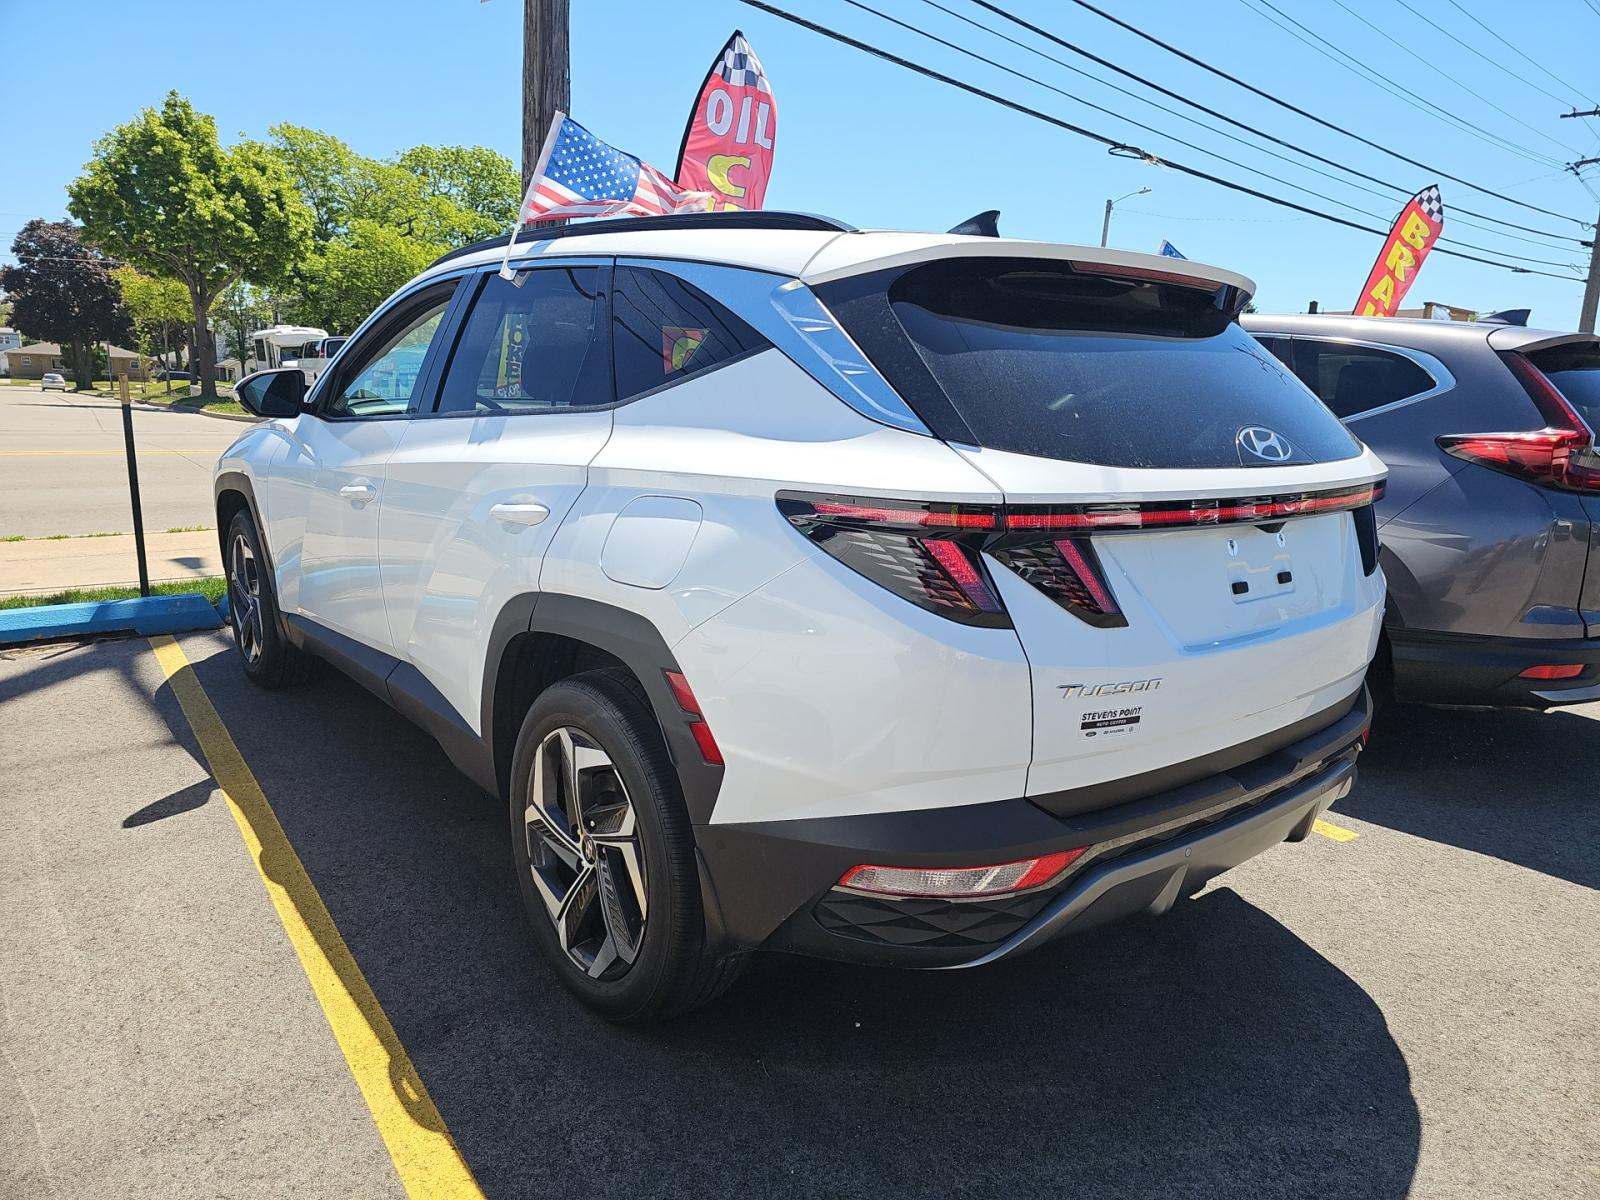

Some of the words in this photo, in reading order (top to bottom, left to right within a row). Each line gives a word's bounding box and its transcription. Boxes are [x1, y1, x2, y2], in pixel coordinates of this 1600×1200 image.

[706, 88, 774, 151] OIL
[1363, 210, 1431, 316] BRA
[1056, 678, 1163, 699] TUCSON
[1081, 710, 1118, 721] STEVENS
[1118, 707, 1142, 717] POINT
